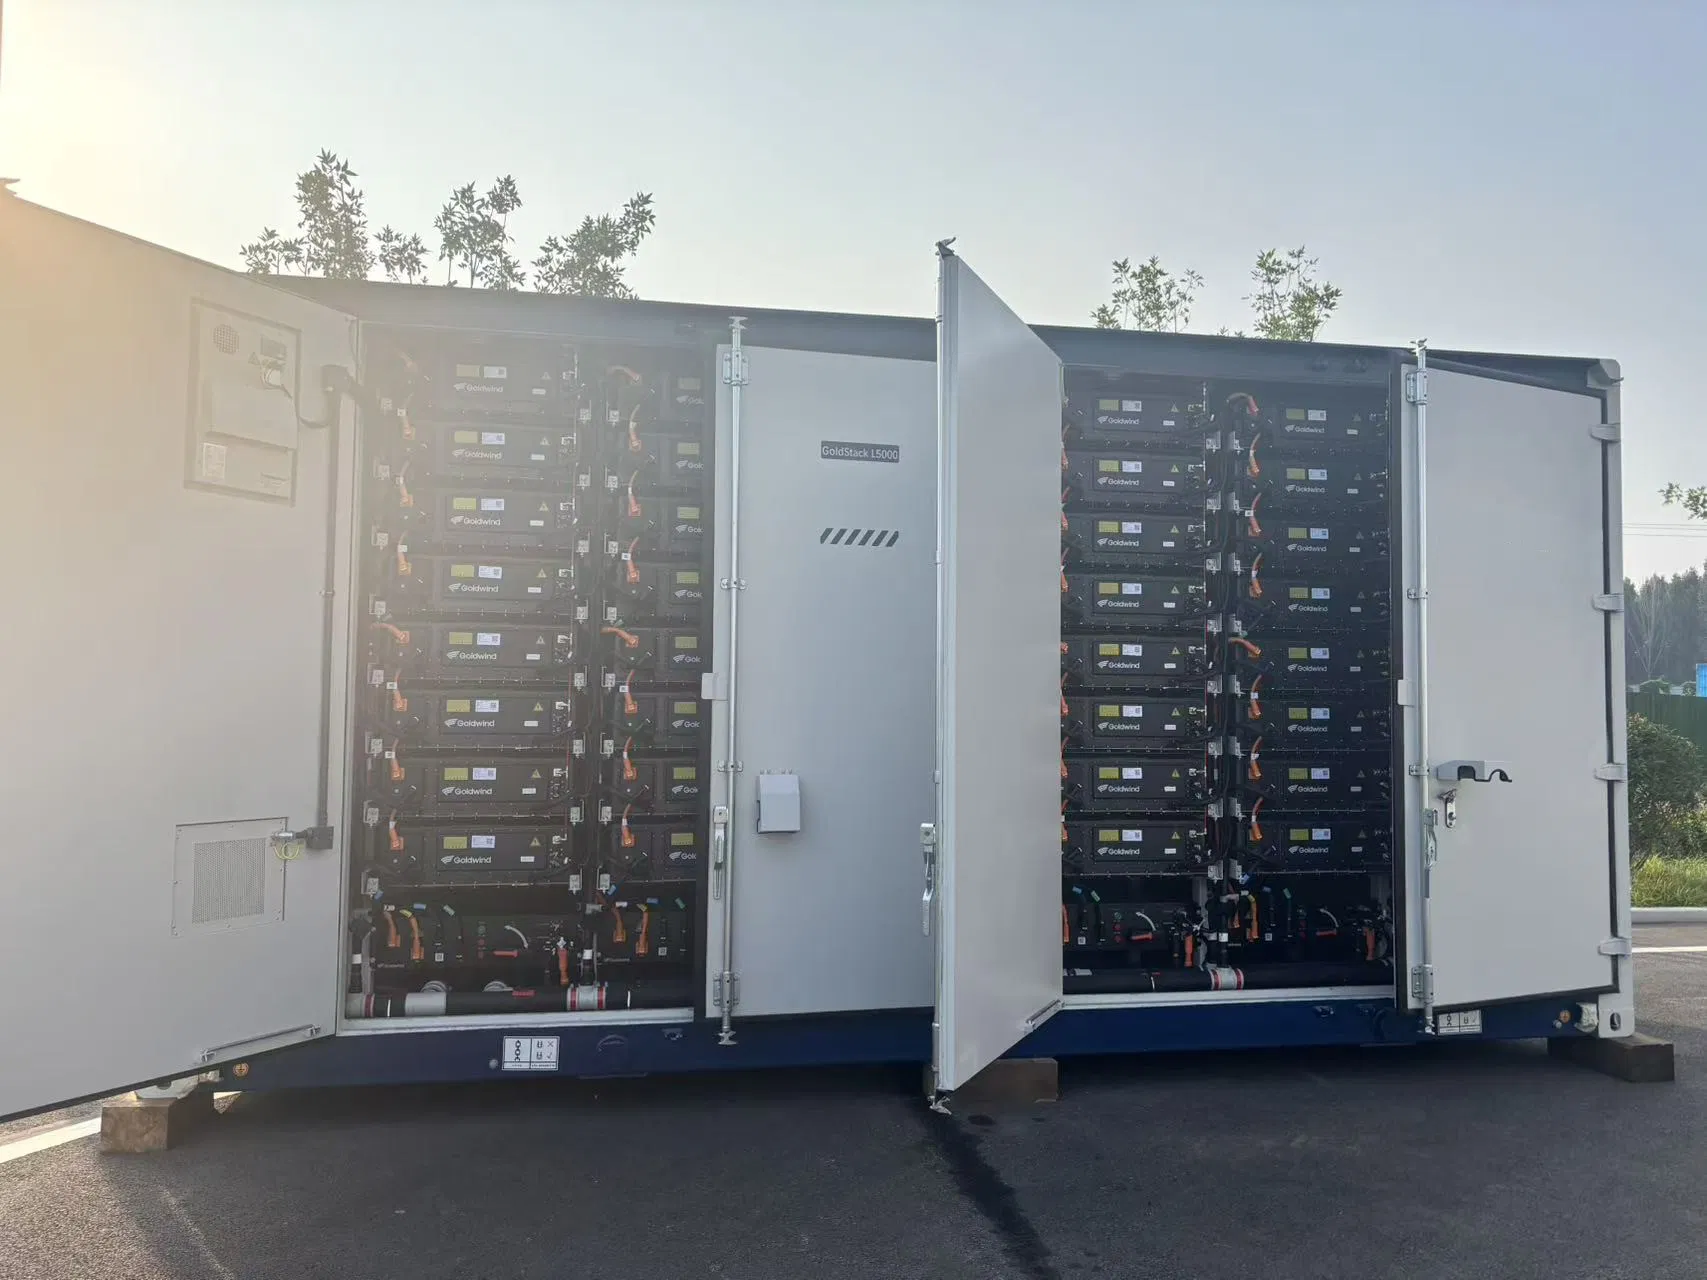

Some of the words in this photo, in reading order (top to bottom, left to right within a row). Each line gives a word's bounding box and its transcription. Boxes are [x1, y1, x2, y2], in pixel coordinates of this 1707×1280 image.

[1107, 416, 1140, 424] Goldwind
[464, 449, 502, 459] Goldwind
[822, 445, 869, 458] GoldStack
[871, 449, 898, 460] L5000
[1107, 477, 1140, 485] Goldwind
[463, 516, 501, 526] Goldwind
[1107, 538, 1140, 547] Goldwind
[1297, 544, 1327, 552] Goldwind
[461, 583, 498, 593] Goldwind
[1107, 599, 1140, 608] Goldwind
[1298, 604, 1328, 612] Goldwind
[459, 651, 497, 660] Goldwind
[1108, 661, 1140, 669] Goldwind
[1297, 664, 1327, 672] Goldwind
[457, 718, 495, 728] Goldwind
[1108, 722, 1140, 730] Goldwind
[1297, 725, 1327, 733] Goldwind
[454, 786, 492, 796] Goldwind
[1108, 784, 1140, 793] Goldwind
[1297, 785, 1327, 793] Goldwind
[1108, 847, 1140, 855] Goldwind
[1298, 846, 1328, 854] Goldwind
[453, 855, 491, 864] Goldwind
